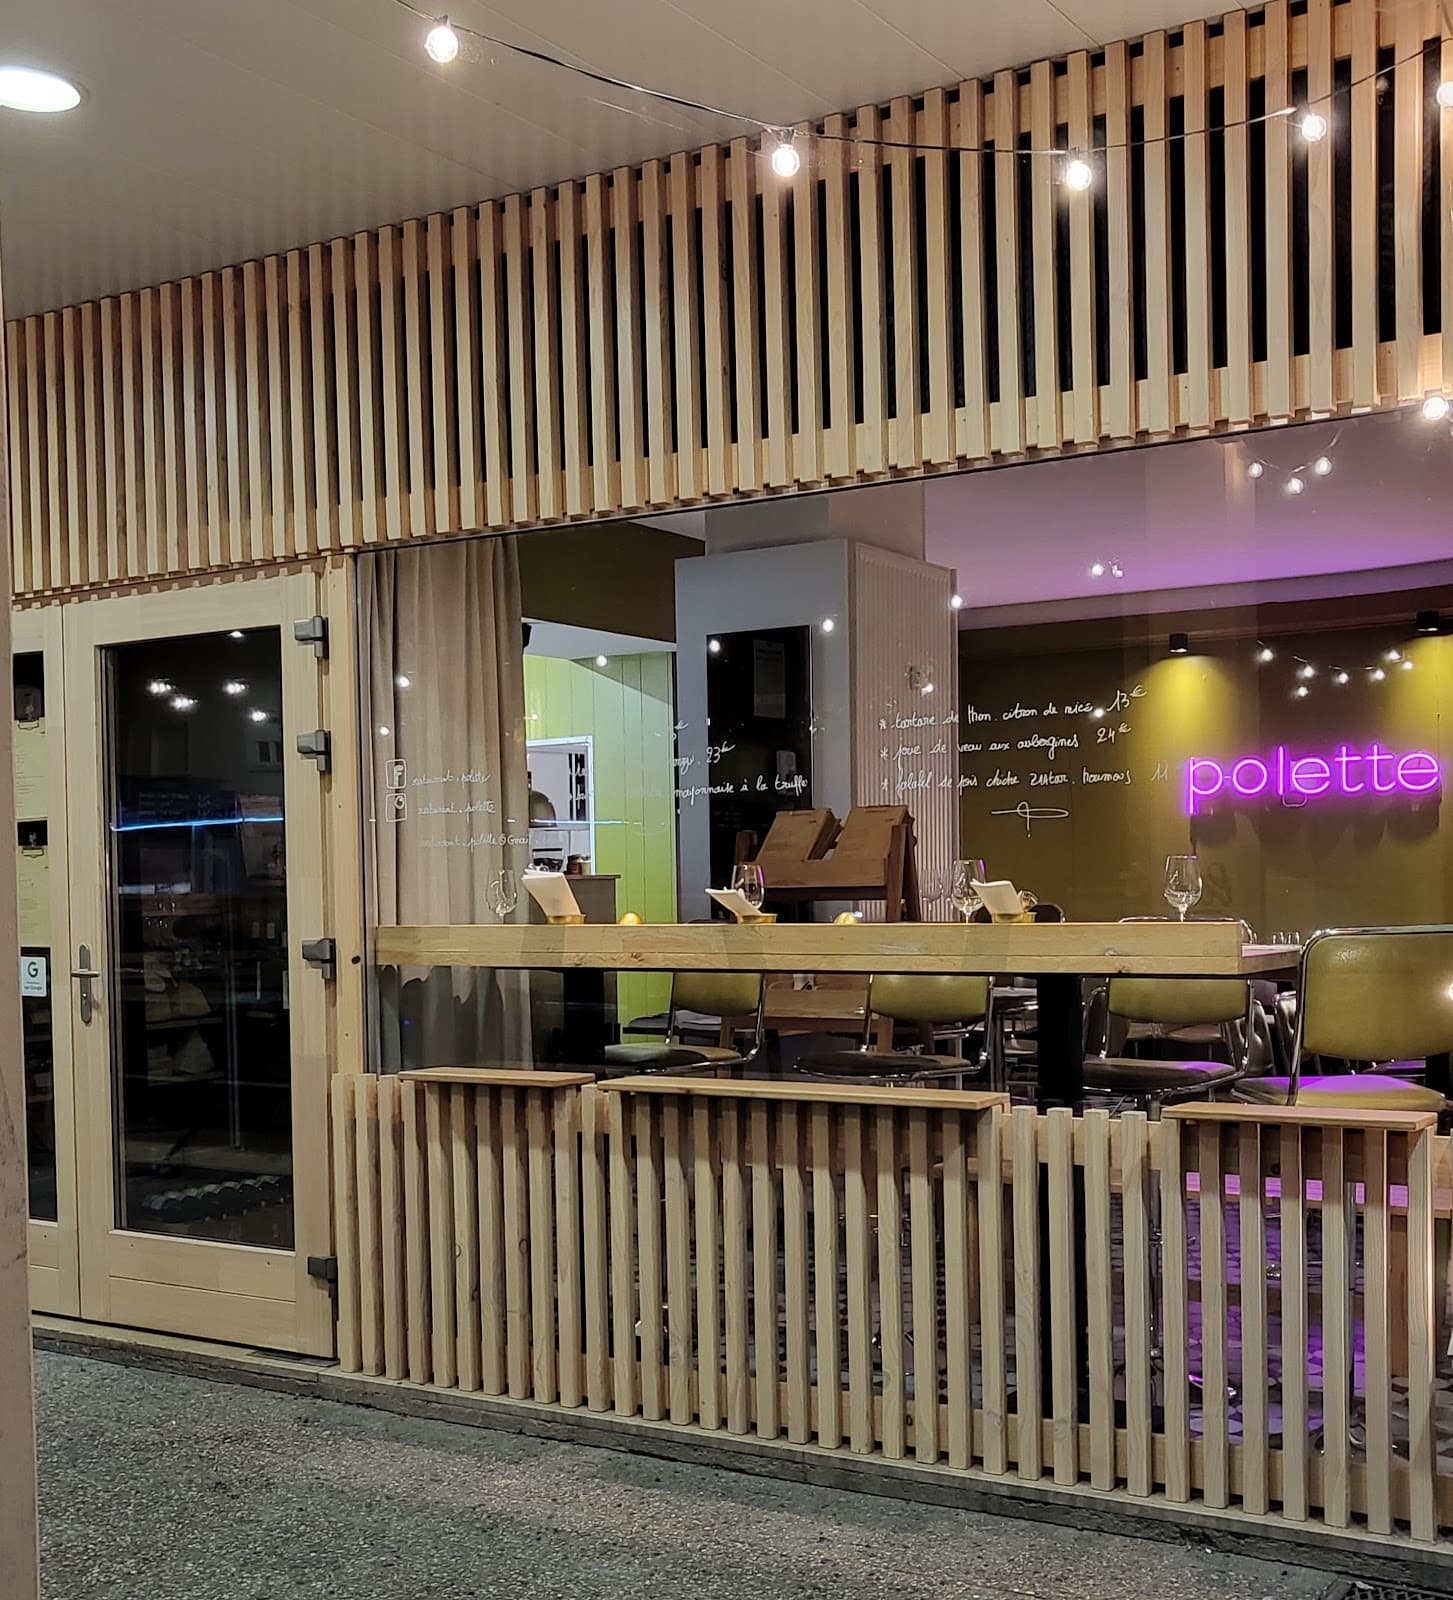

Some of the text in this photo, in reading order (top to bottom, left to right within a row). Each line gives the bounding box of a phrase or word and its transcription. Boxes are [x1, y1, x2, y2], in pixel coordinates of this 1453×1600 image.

[891, 711, 936, 729] tartare
[1002, 702, 1038, 720] citron
[1043, 702, 1059, 715] de
[929, 738, 947, 754] de
[988, 742, 1011, 752] aux
[1017, 733, 1079, 761] aubergines
[739, 779, 750, 792] à
[756, 775, 769, 792] la
[775, 774, 809, 798] truffe
[1187, 743, 1440, 816] polette
[27, 961, 39, 978] G
